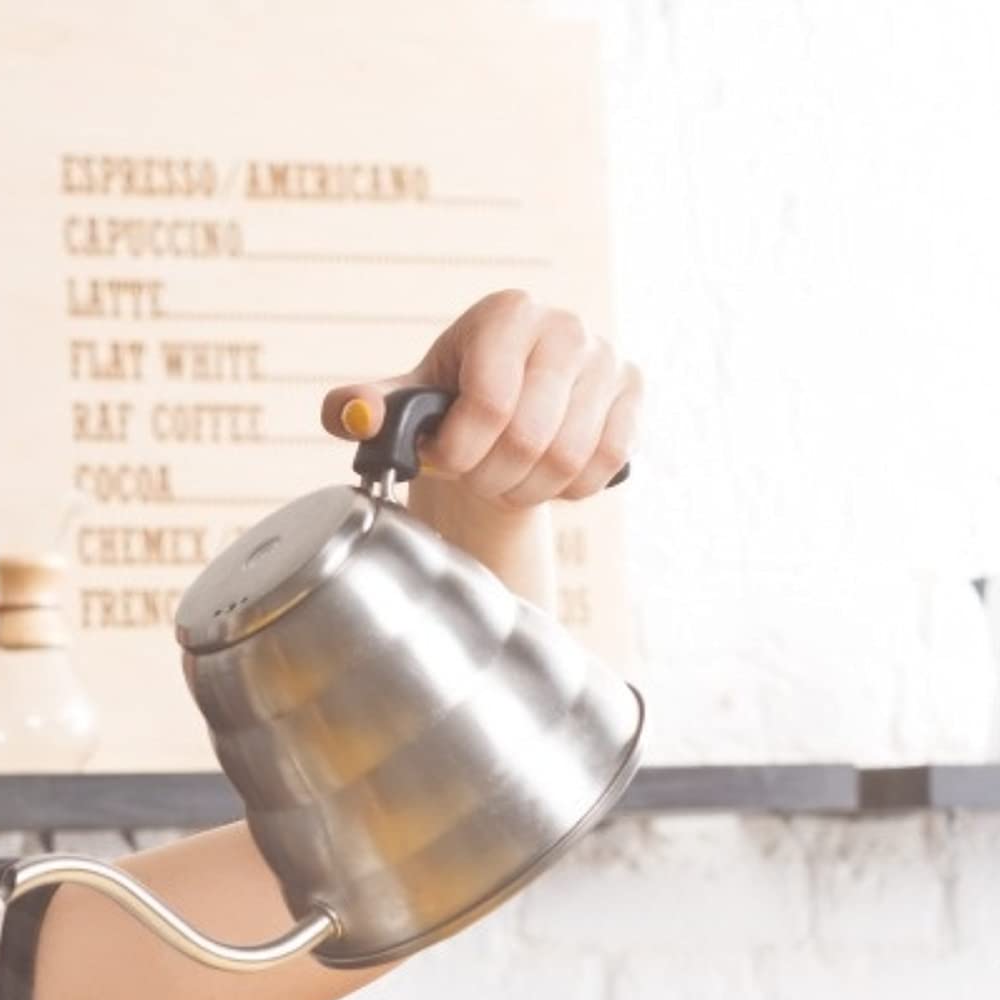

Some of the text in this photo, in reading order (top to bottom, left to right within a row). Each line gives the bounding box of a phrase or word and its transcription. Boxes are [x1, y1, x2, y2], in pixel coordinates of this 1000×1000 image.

[63, 215, 245, 258] CAPUCCINO
[66, 278, 165, 319] LATTE
[69, 339, 264, 382] FLAT WHITE
[72, 401, 264, 444] RAF COFFEE
[80, 588, 181, 630] FRENC
